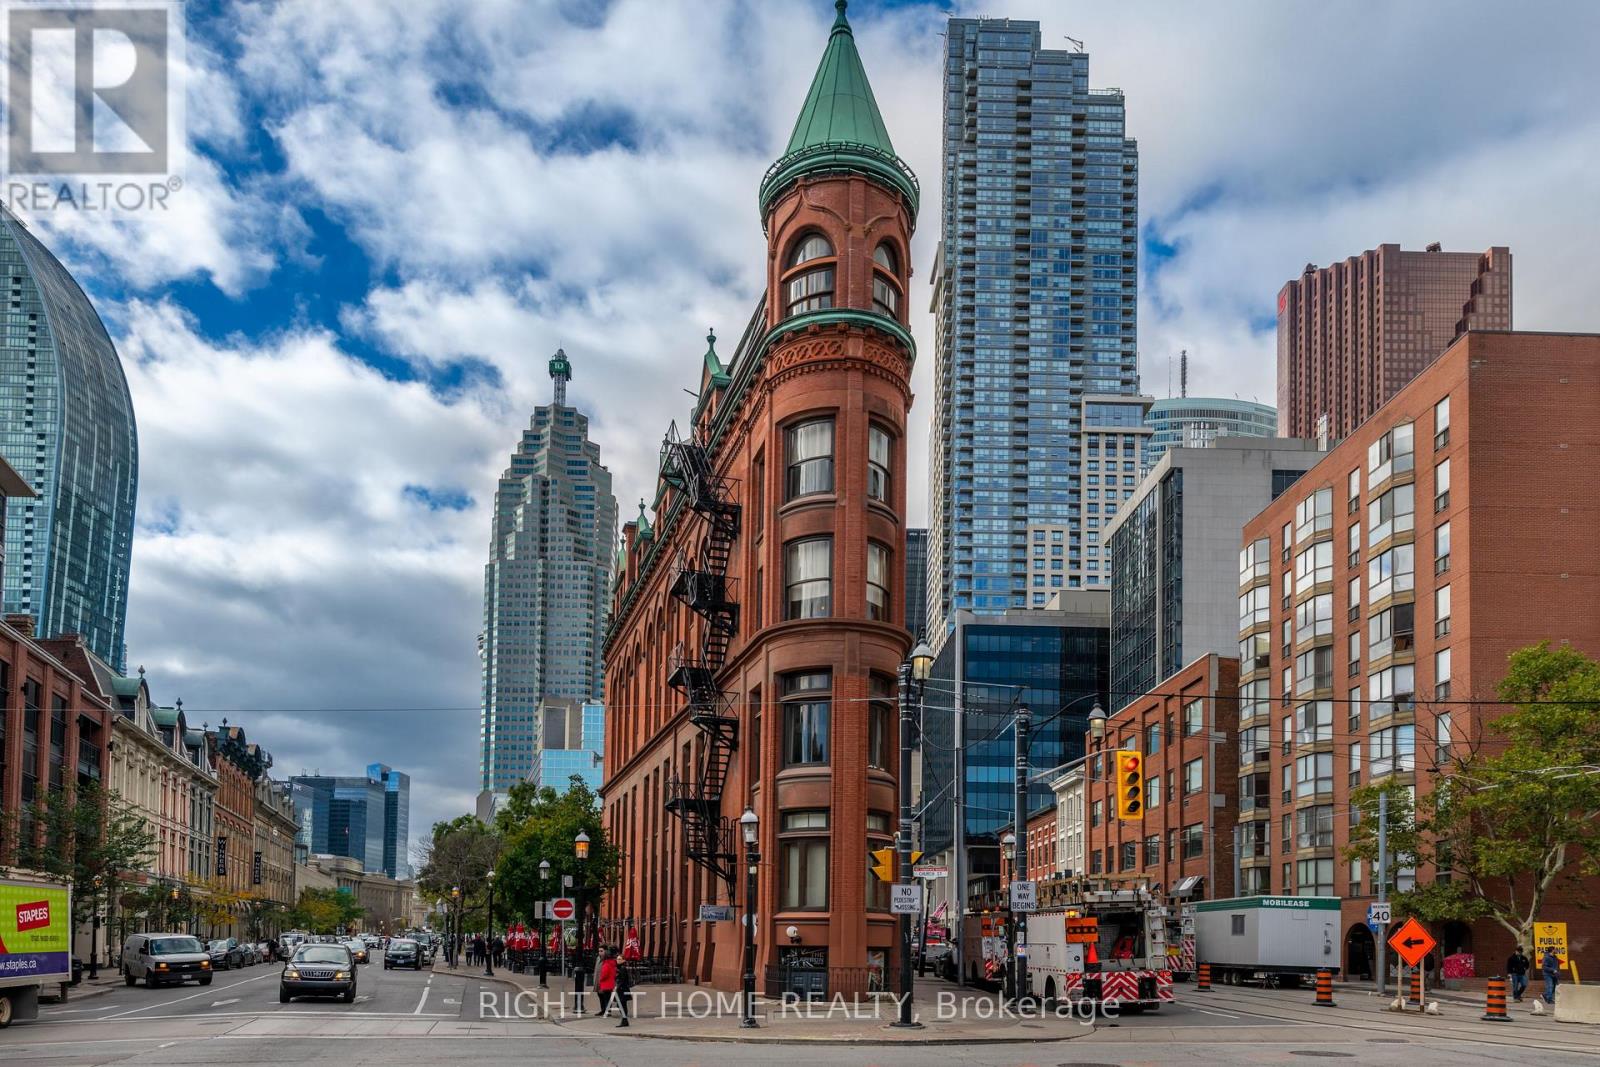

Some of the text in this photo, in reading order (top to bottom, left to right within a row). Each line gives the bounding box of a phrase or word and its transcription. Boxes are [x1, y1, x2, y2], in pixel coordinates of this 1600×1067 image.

[901, 887, 912, 896] NO
[1017, 883, 1031, 891] ONE
[1017, 892, 1030, 900] WAY
[1012, 901, 1035, 910] BEGINS
[1262, 899, 1310, 907] MOBILEASE
[18, 907, 49, 924] STAPLES
[1373, 911, 1390, 921] 40
[1539, 937, 1563, 946] PUBLIC
